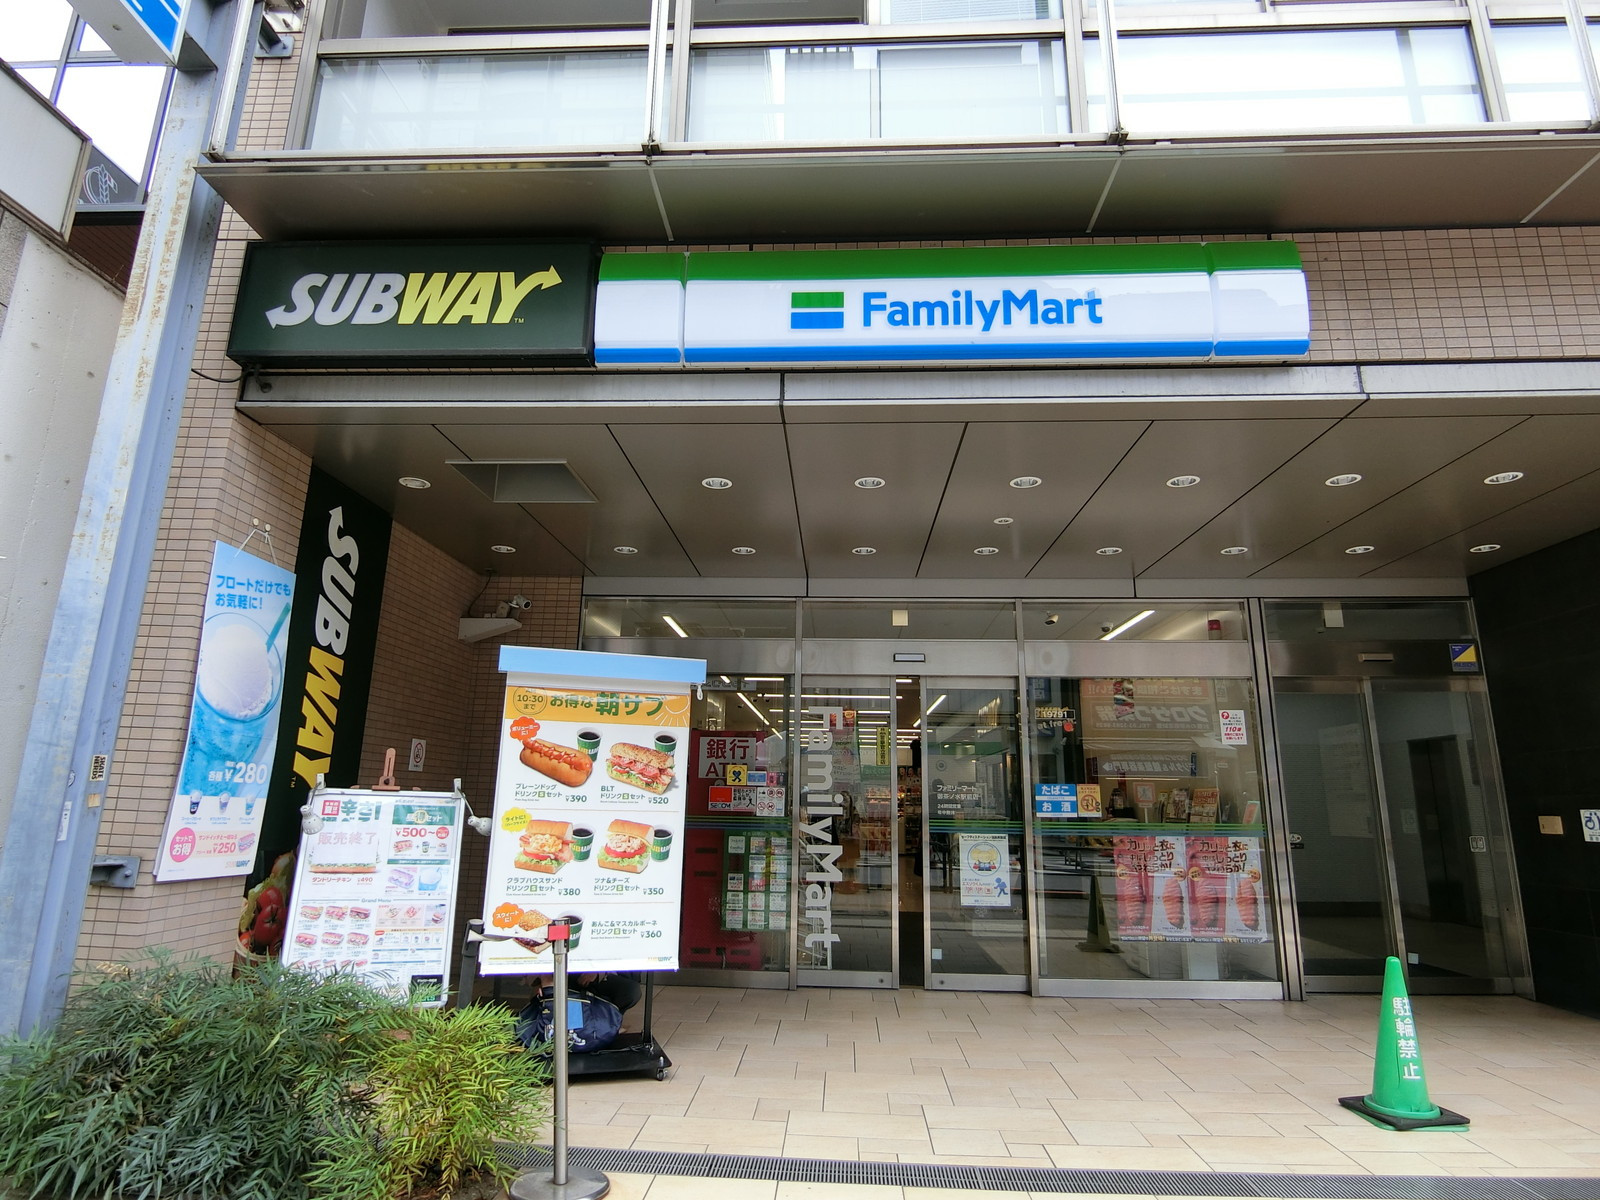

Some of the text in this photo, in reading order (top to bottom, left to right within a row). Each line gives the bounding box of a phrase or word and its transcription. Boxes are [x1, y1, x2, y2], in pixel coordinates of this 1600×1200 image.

[266, 265, 562, 329] SUBWAY
[862, 289, 1103, 332] FamilyMart
[215, 574, 291, 597] フロートだけでも
[215, 593, 263, 610] お気軽に!
[293, 506, 359, 789] SUBWAY
[517, 694, 544, 703] 10:30
[706, 738, 750, 760] 銀行
[91, 755, 100, 780] NERDS
[98, 756, 106, 779] SKATE
[224, 761, 268, 785] ¥280
[936, 784, 977, 792] ファミリーマート
[1041, 785, 1070, 795] たばこ
[566, 795, 587, 803] ¥390
[648, 797, 669, 805] ¥520
[799, 706, 843, 949] FamilyMart
[318, 831, 377, 845] 販売終了
[172, 842, 193, 856] お得
[213, 842, 237, 854] ¥250
[558, 888, 581, 896] ¥380
[643, 887, 665, 895] ¥350
[640, 930, 663, 938] ¥360
[1392, 997, 1421, 1080] 駐輪禁止
